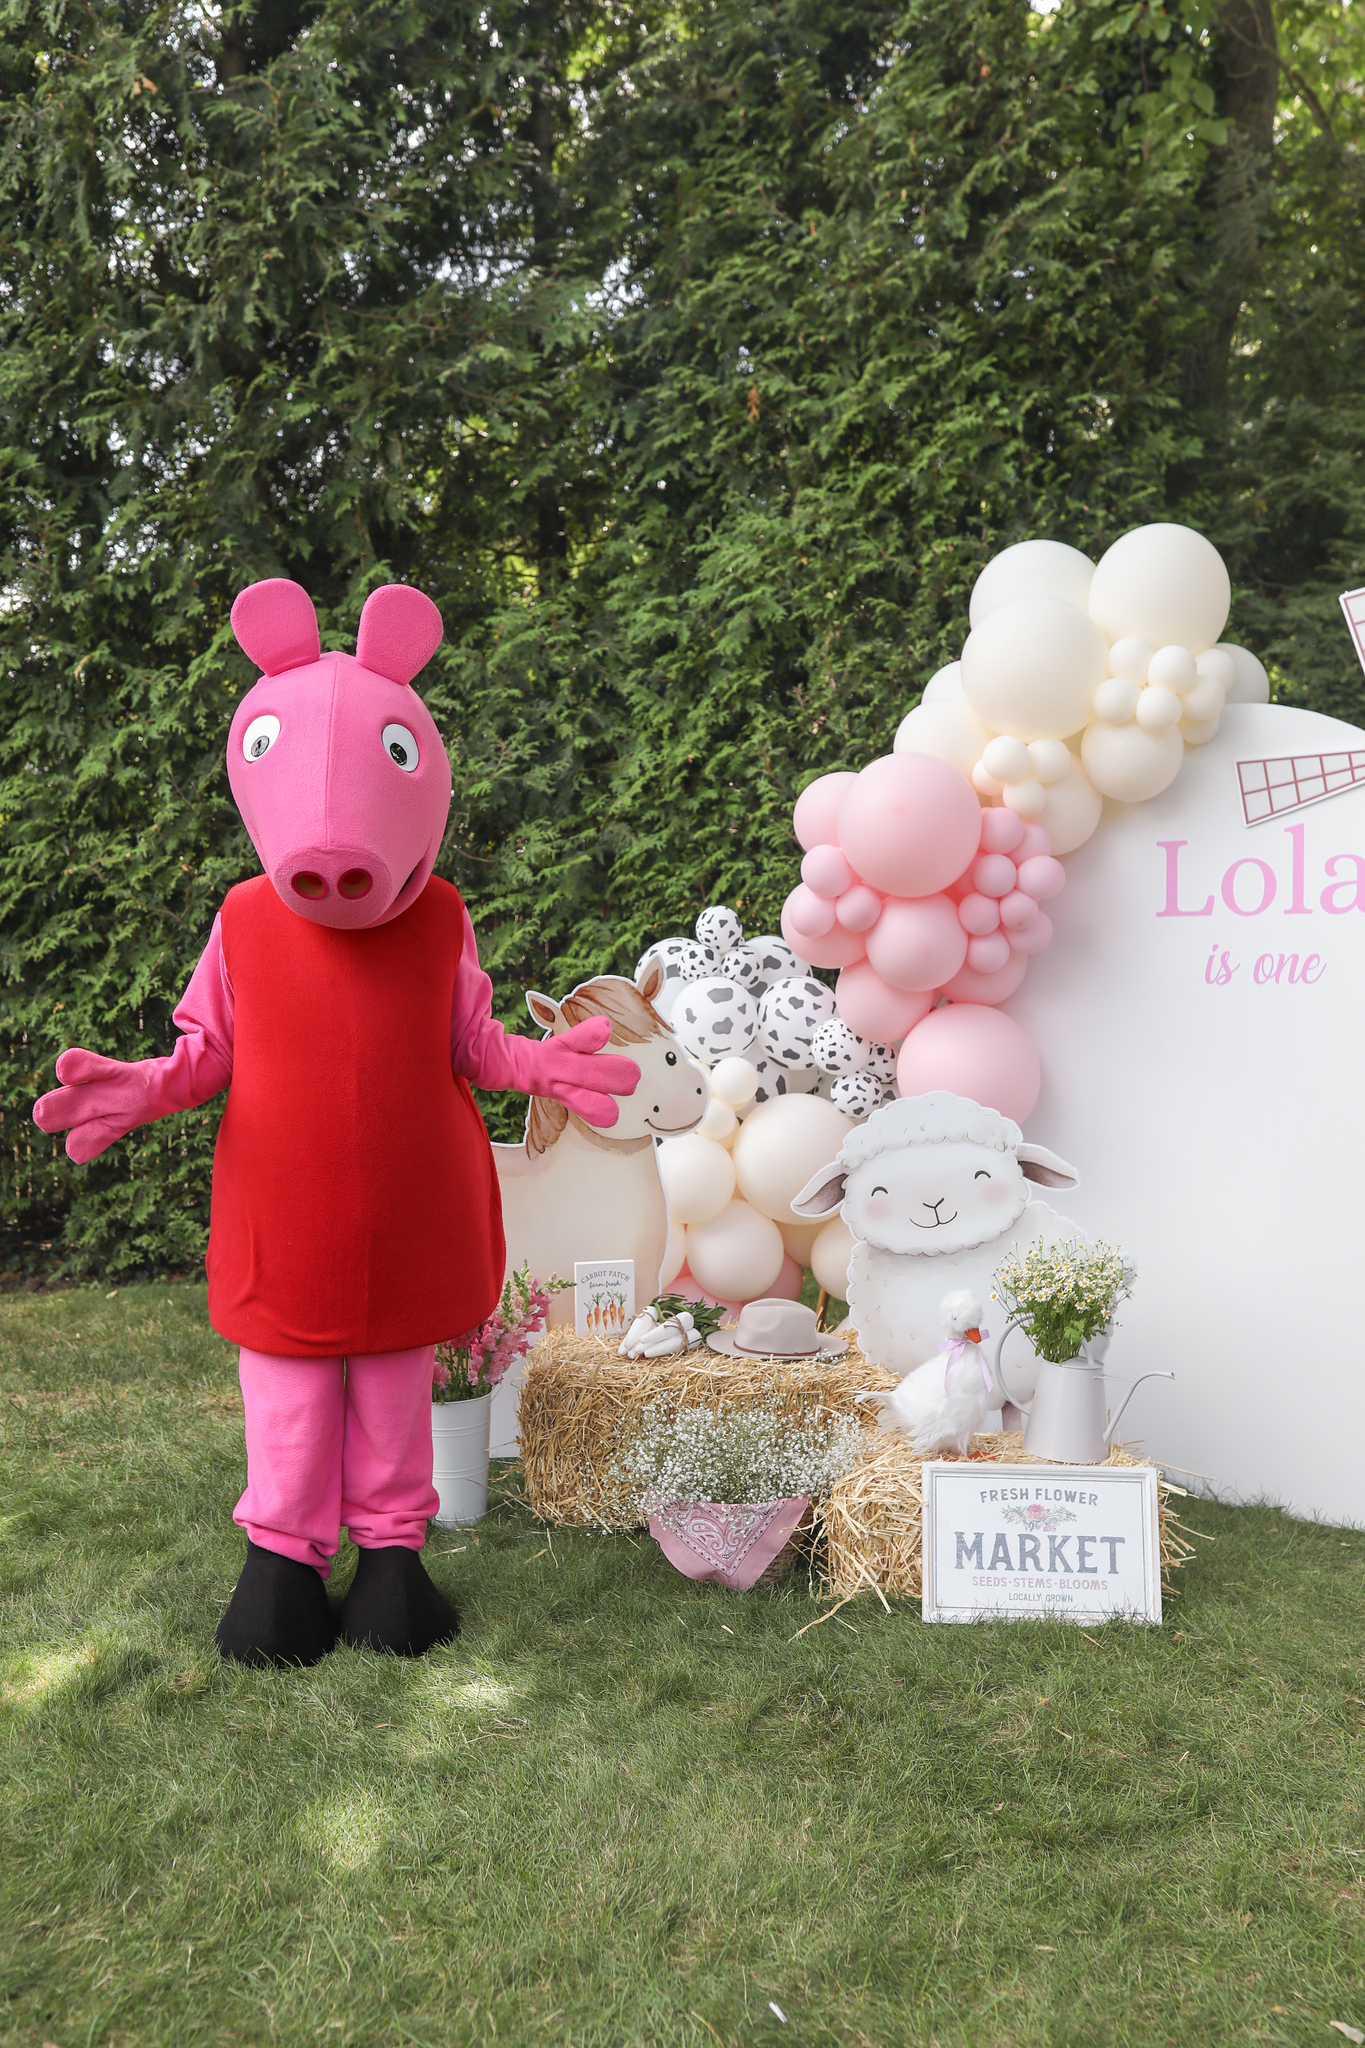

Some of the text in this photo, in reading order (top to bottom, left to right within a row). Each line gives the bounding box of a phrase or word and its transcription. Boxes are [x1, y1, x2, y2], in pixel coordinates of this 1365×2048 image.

[1156, 823, 1365, 917] Lola
[1205, 944, 1327, 985] is one
[581, 1271, 630, 1284] CARROT PATCH
[606, 1280, 622, 1288] fresh
[980, 1488, 1098, 1506] FRESH FLOWER
[954, 1531, 1126, 1574] MARKET
[1008, 1592, 1073, 1603] LOCALLY GROWN
